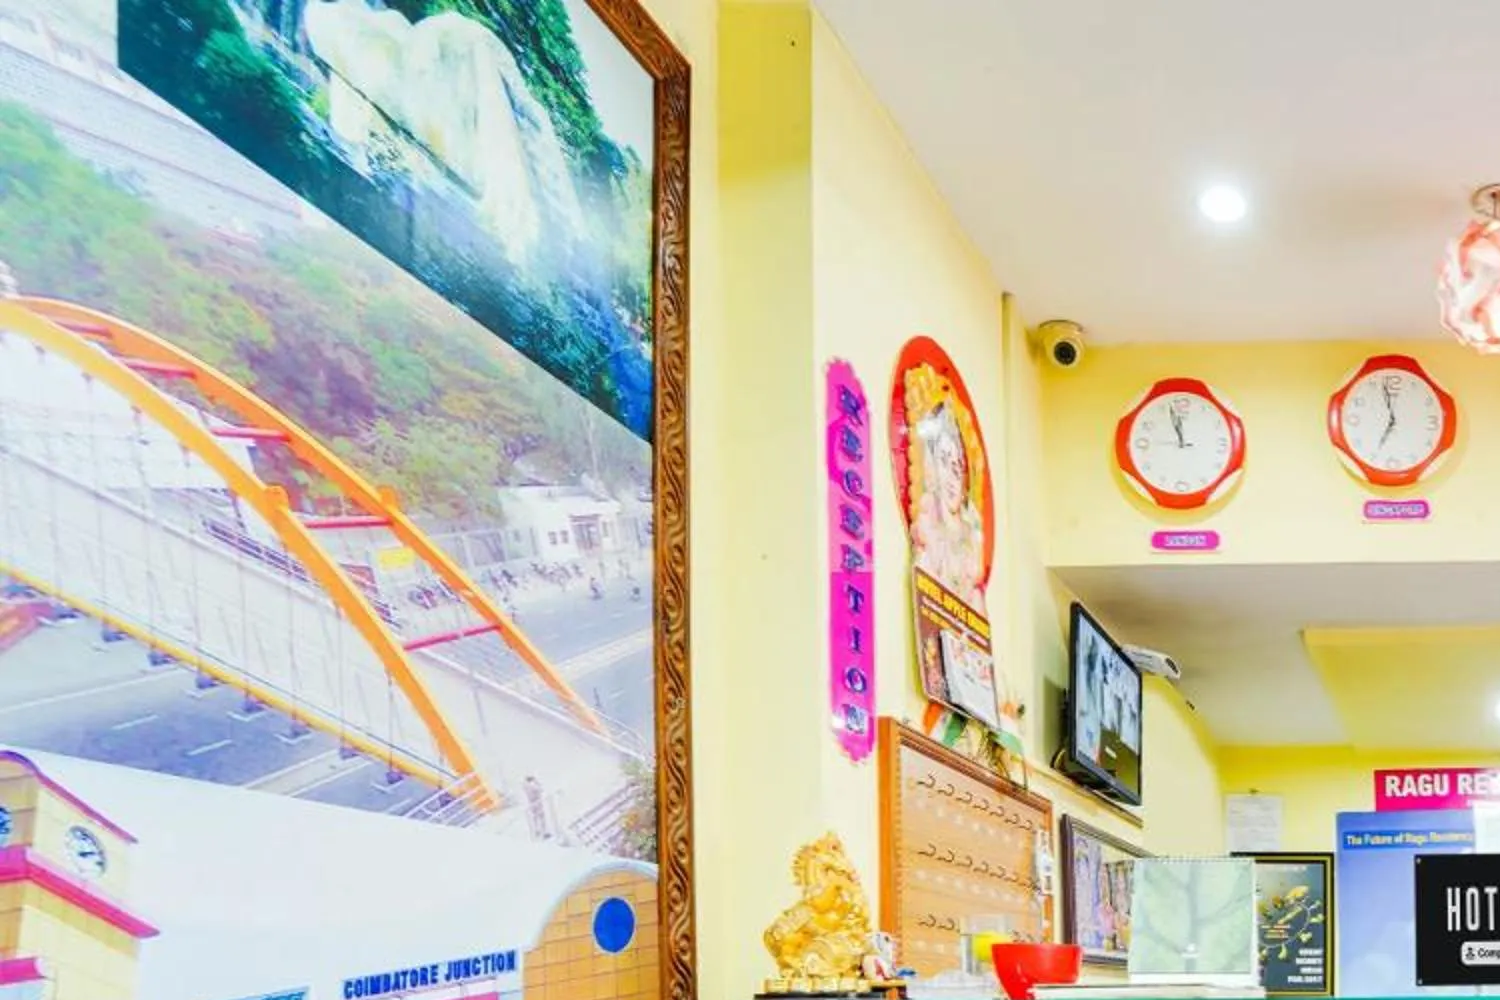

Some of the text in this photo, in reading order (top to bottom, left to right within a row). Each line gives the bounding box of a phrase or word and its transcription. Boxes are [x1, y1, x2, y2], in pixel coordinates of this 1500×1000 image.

[1384, 772, 1450, 798] RAGU
[343, 949, 517, 1000] COIMBATORE JUNCTION
